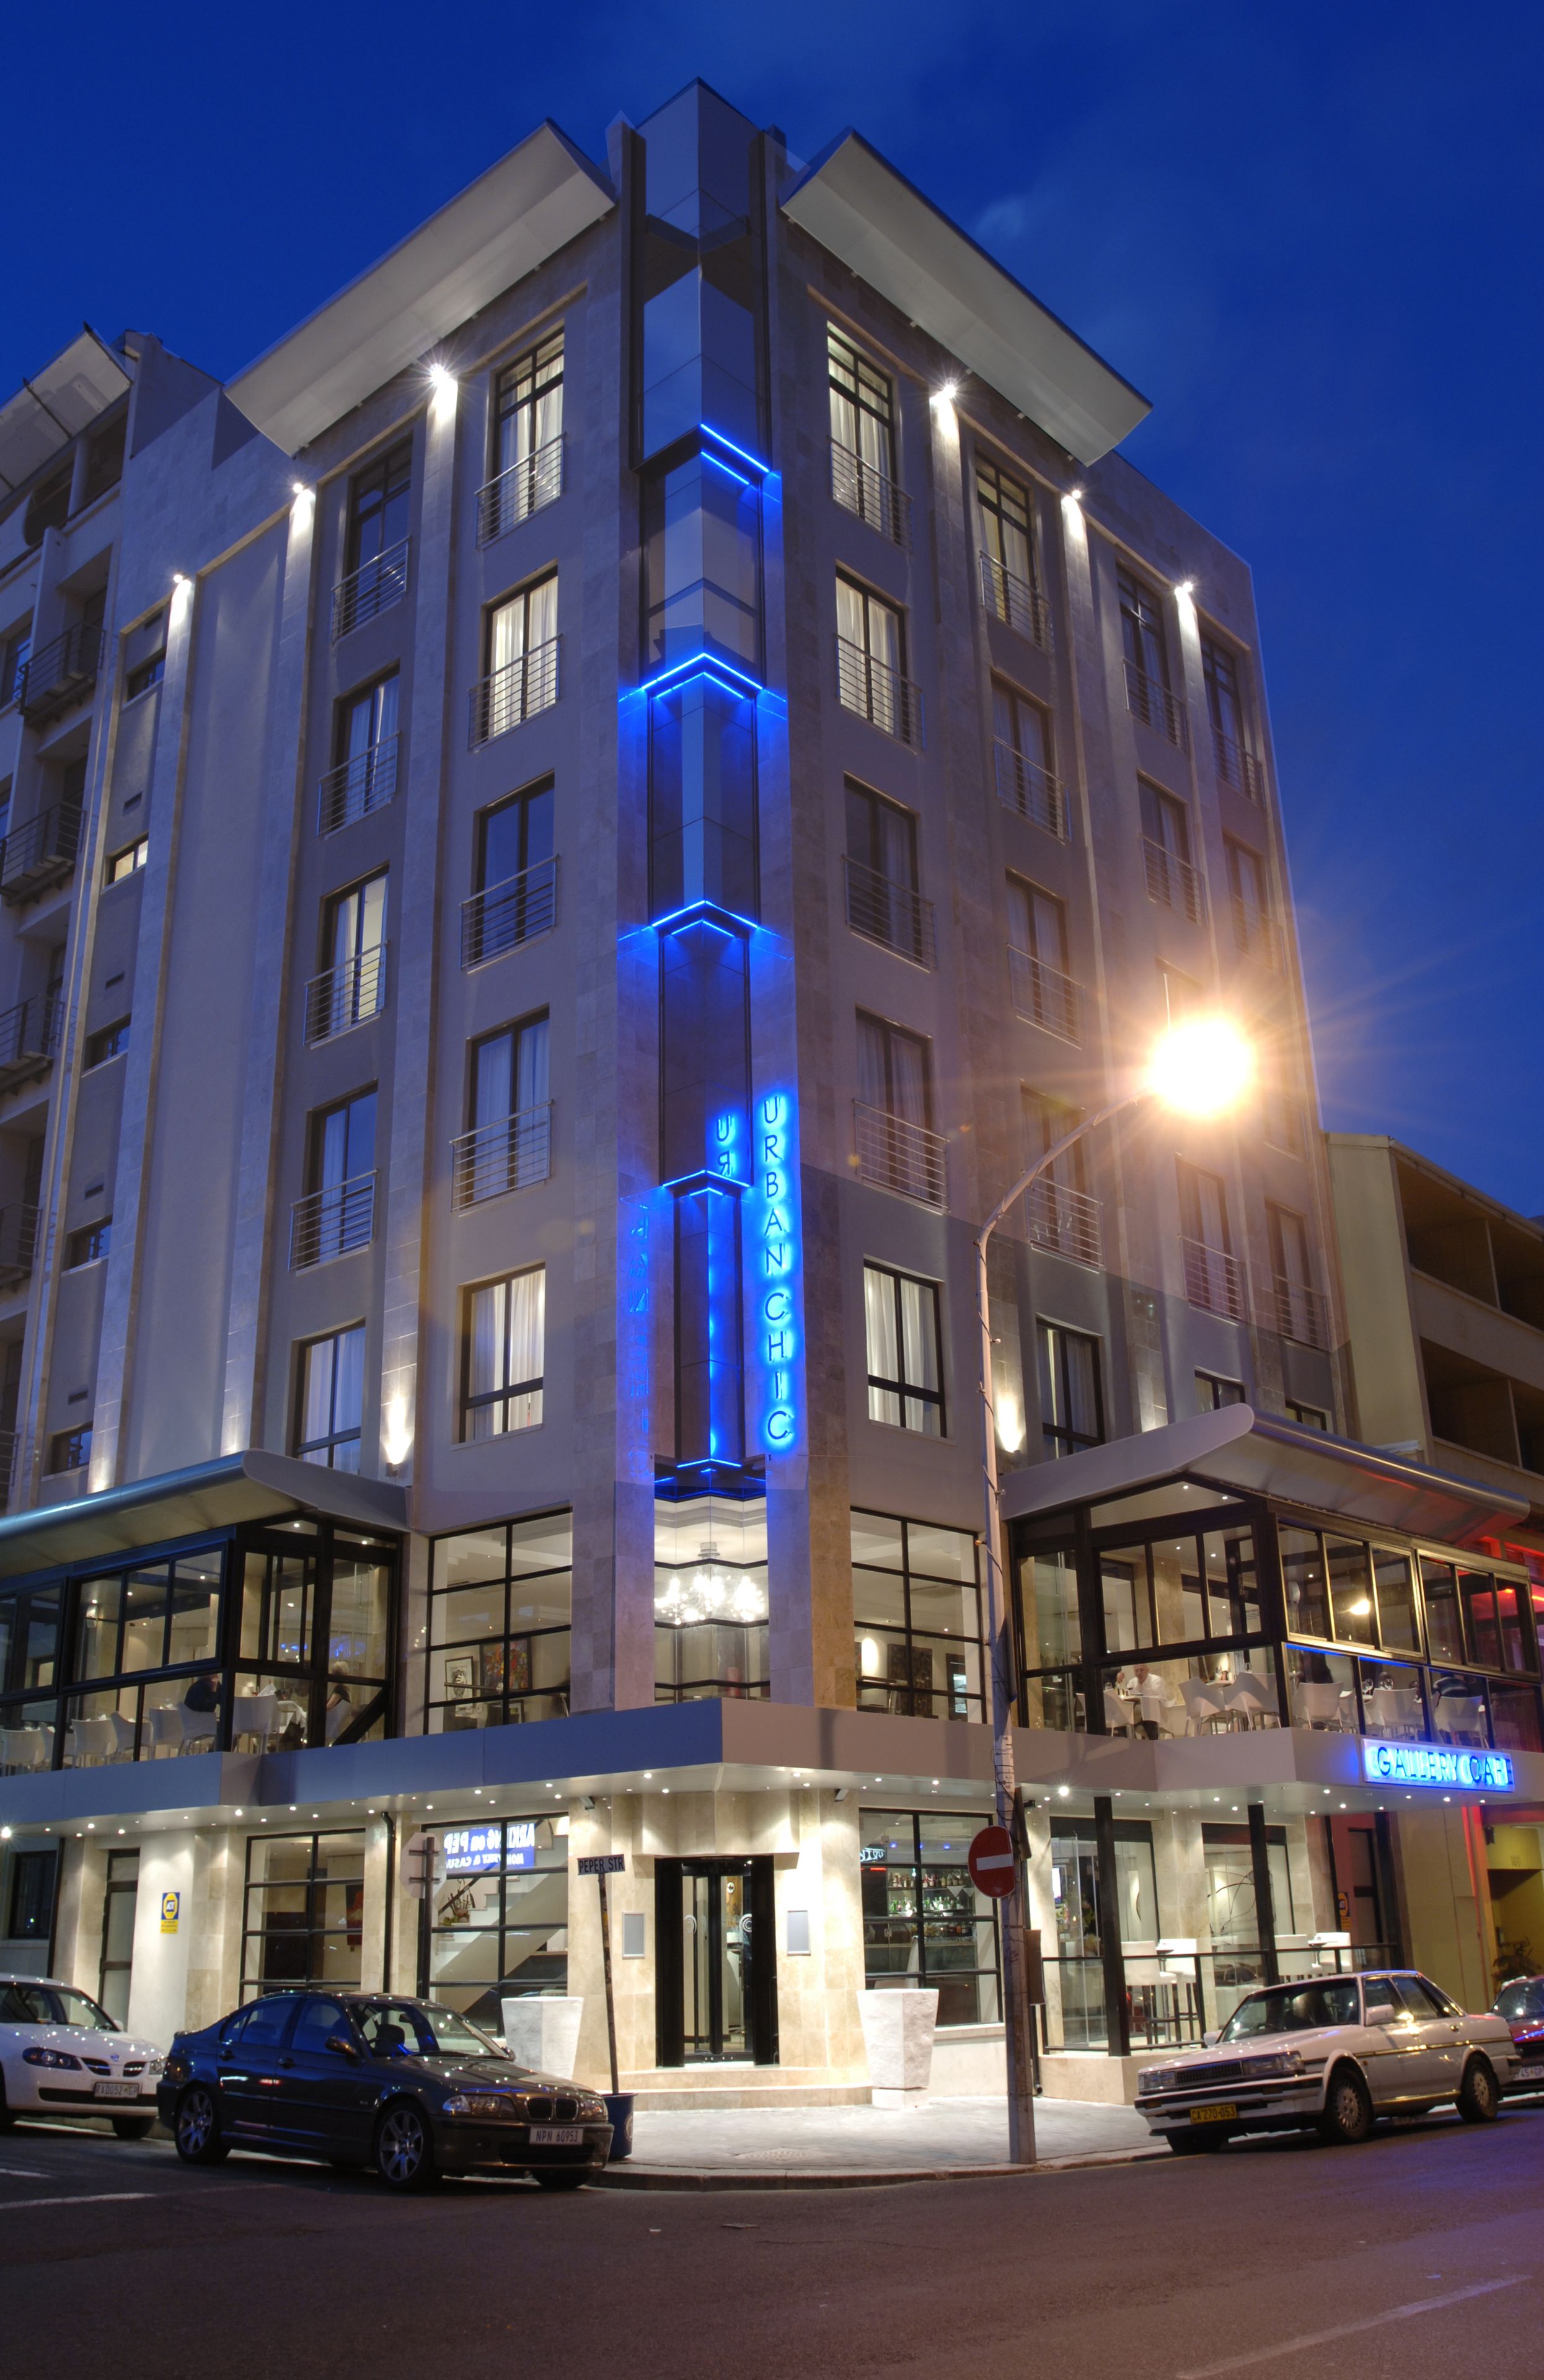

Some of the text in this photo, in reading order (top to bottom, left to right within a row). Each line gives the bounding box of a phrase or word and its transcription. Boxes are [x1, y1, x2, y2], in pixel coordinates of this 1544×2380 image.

[763, 1095, 793, 1440] URBAN CHIC
[1369, 1746, 1458, 1782] GALLERY
[578, 1857, 624, 1874] PEPER STR
[536, 2130, 579, 2142] NPN 60953
